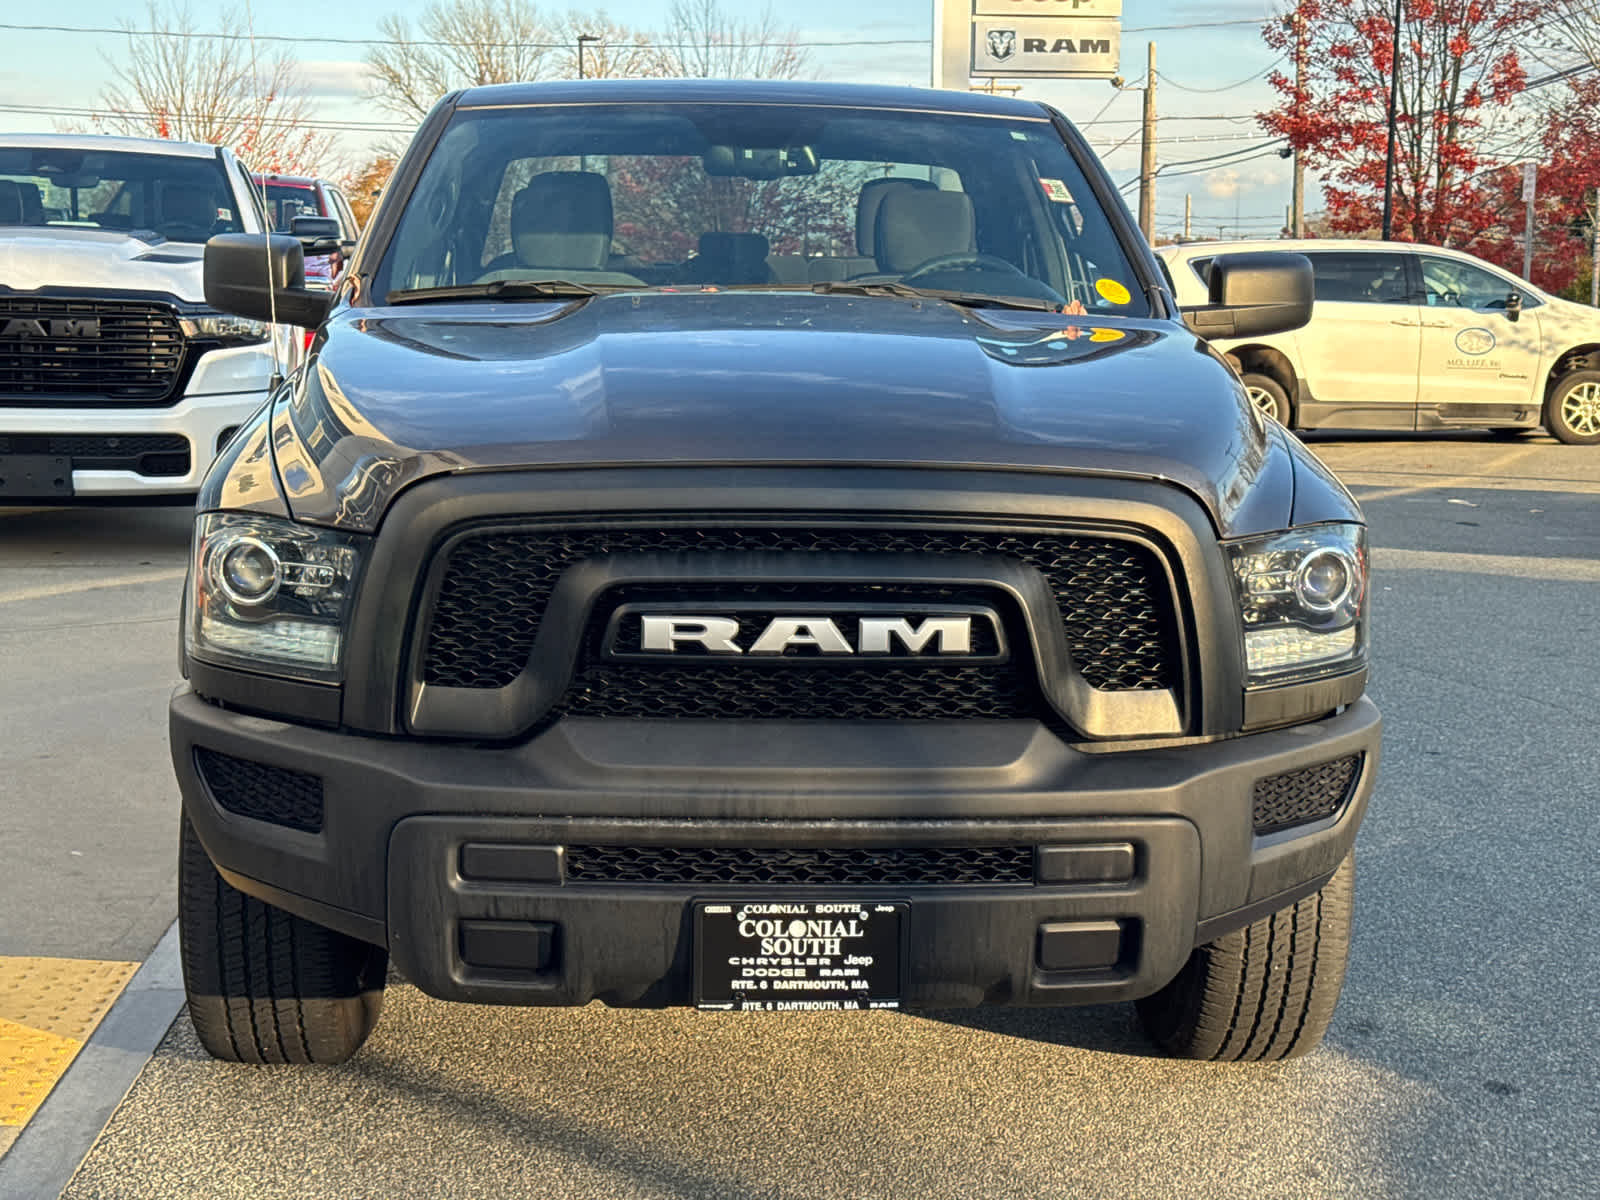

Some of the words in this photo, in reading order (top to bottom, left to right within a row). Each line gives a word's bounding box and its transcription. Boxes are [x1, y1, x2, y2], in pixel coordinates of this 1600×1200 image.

[1023, 38, 1110, 53] RAM
[0, 318, 101, 337] AM
[641, 615, 971, 653] RAM
[743, 904, 809, 914] COLONIAL
[815, 904, 861, 913] SOUTH
[738, 920, 864, 937] COLONIAL
[760, 938, 842, 955] SOUTH
[728, 957, 831, 966] CHRYSLER
[843, 954, 873, 966] Jeep
[742, 968, 807, 977] DODGE
[819, 968, 860, 977] RAM
[731, 980, 758, 990] RTE.
[759, 980, 769, 990] 6
[772, 980, 850, 991] DARTMOUTH,
[851, 980, 870, 990] MA
[742, 1001, 765, 1011] RTE.
[776, 1001, 842, 1011] DARTMOUTH,
[843, 1001, 860, 1010] MA
